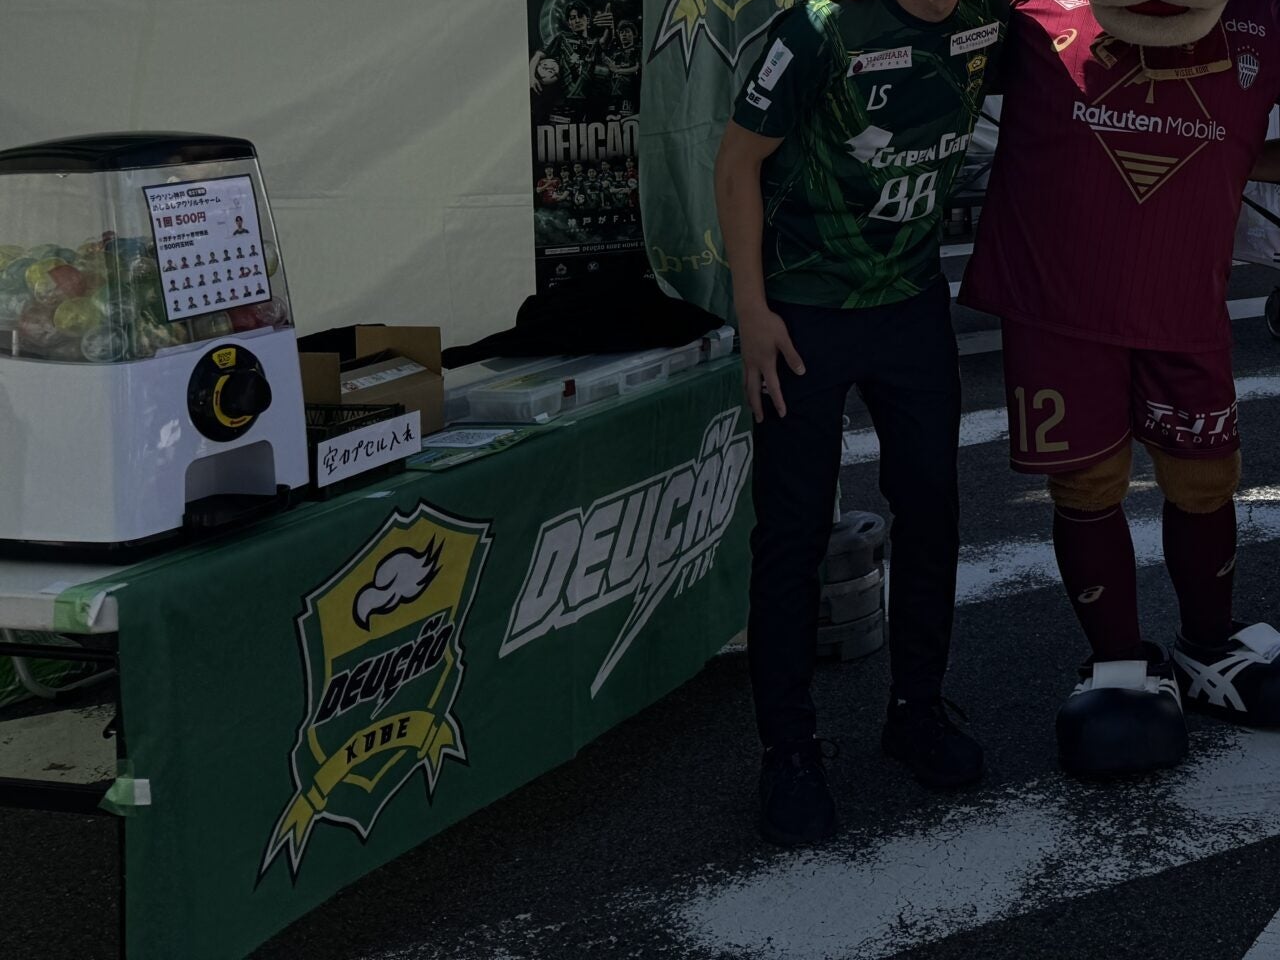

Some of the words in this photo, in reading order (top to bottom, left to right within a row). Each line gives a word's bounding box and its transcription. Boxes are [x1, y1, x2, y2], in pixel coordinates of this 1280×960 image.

[952, 27, 998, 47] MILKCROWN
[1225, 19, 1267, 37] debs
[1072, 101, 1162, 133] Rakuten
[1165, 116, 1226, 141] Mobile
[868, 171, 939, 222] 88
[156, 216, 173, 228] 1回
[175, 211, 207, 225] 500円
[1015, 386, 1070, 453] 12
[323, 423, 416, 476] 空カプセル入れ
[345, 717, 411, 763] KOBE
